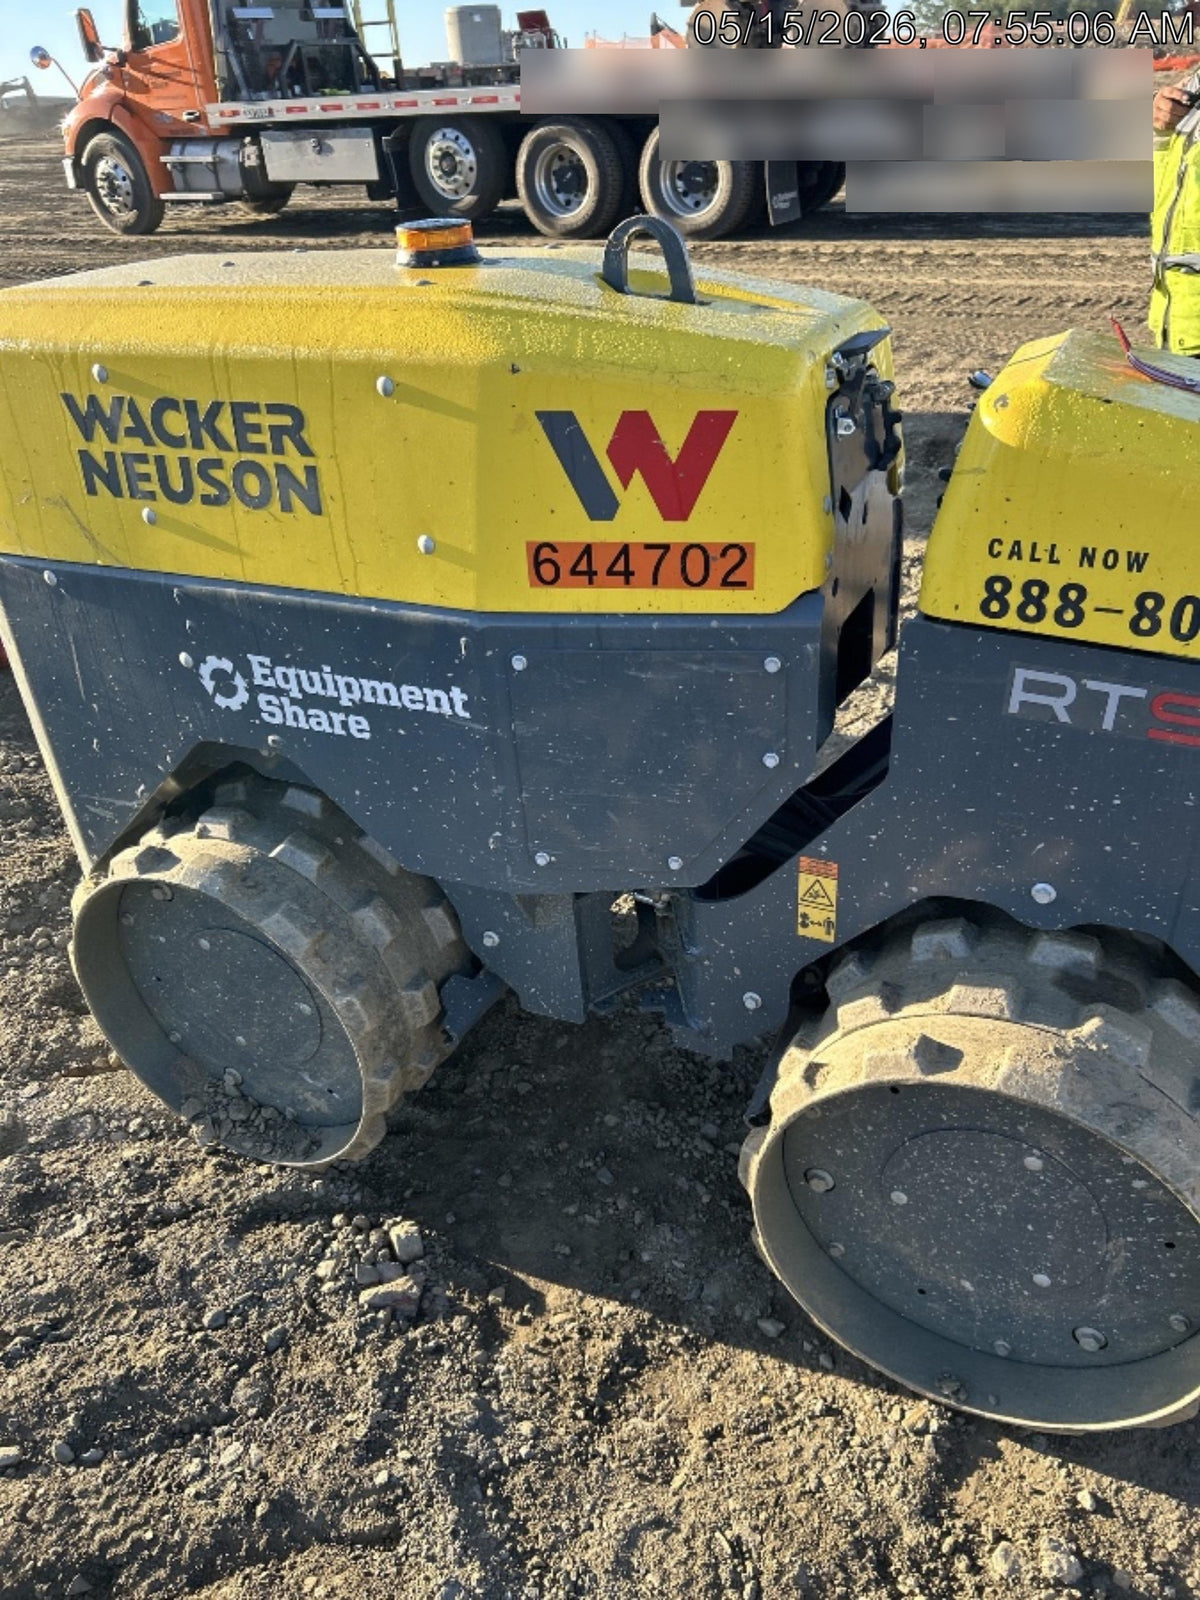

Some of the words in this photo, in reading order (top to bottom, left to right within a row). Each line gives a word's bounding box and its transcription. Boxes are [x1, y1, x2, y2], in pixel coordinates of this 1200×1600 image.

[60, 392, 316, 457] WACKER
[78, 449, 323, 517] NEUSON
[532, 541, 749, 588] 644702
[988, 538, 1061, 565] CALL
[1079, 546, 1150, 573] NOW
[247, 653, 471, 720] Equipment
[258, 692, 371, 740] Share
